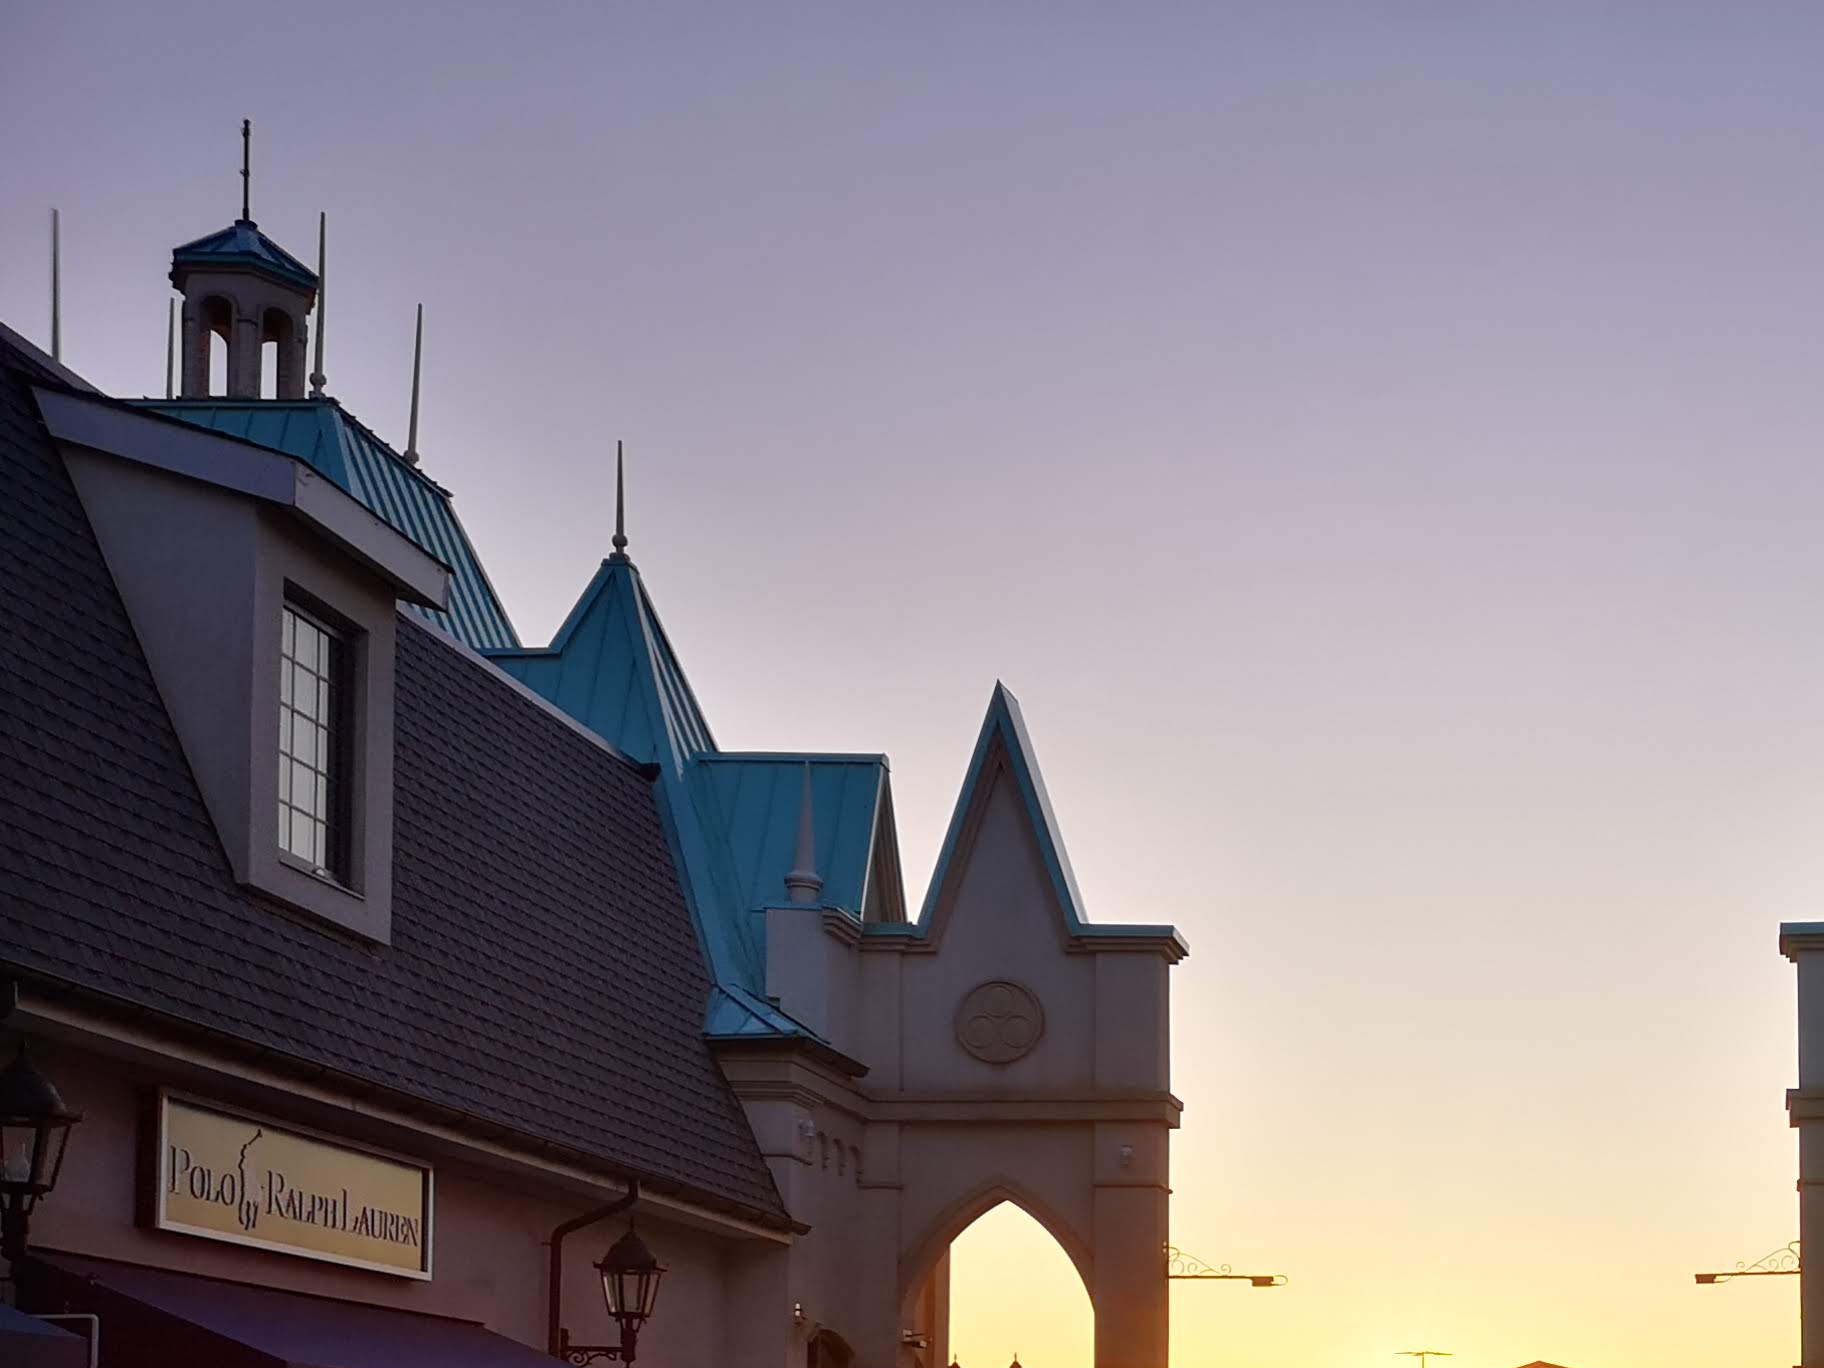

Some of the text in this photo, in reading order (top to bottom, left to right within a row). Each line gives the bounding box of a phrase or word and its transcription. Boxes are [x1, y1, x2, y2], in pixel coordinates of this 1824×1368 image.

[169, 1145, 419, 1248] POLO RALPH LAUREN
